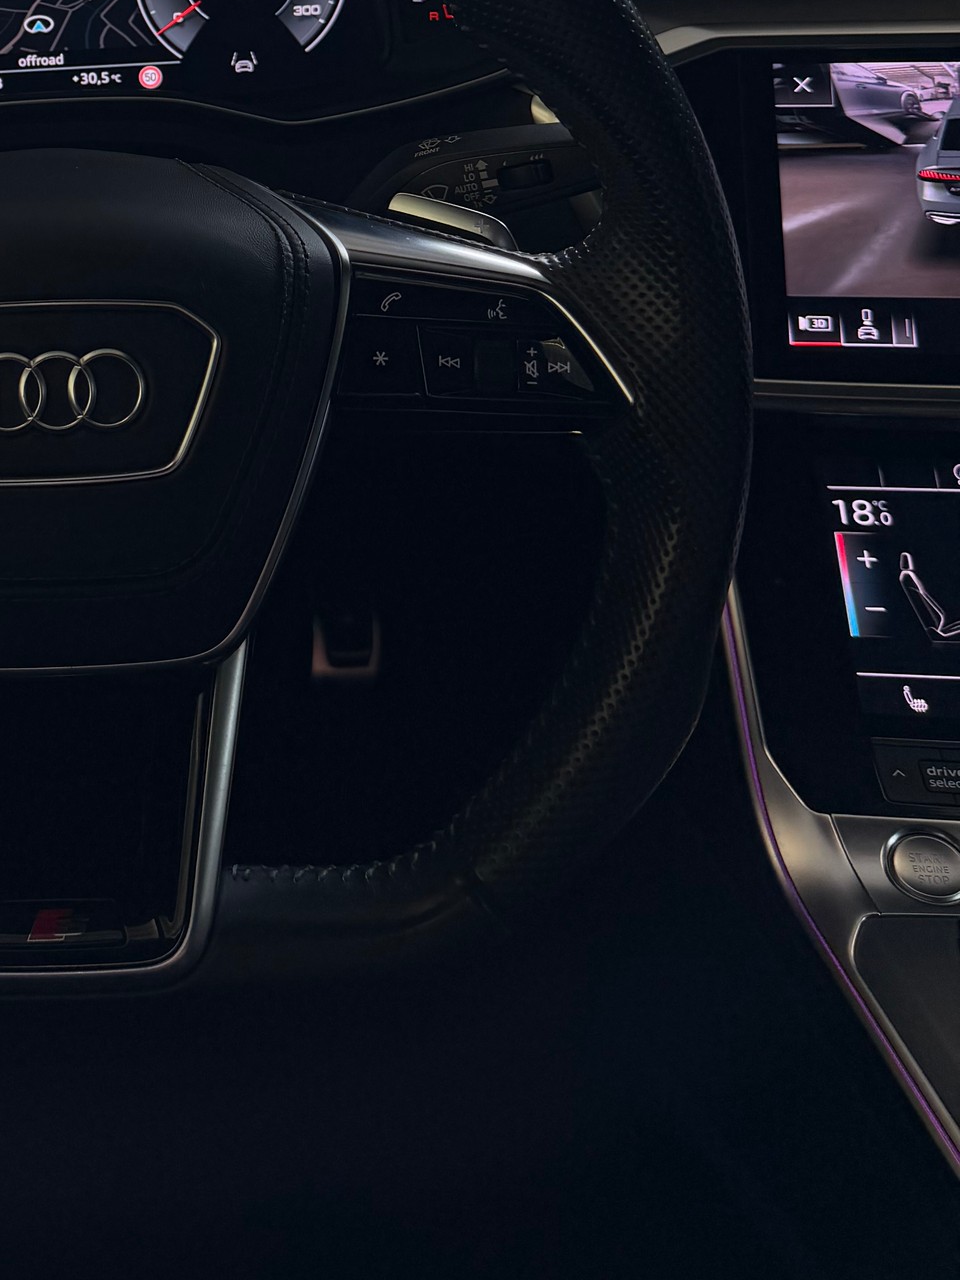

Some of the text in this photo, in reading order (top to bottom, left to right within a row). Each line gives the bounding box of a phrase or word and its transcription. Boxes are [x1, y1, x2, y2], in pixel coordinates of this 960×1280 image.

[293, 5, 321, 16] 300
[18, 53, 64, 67] offroad
[144, 71, 157, 82] 50
[414, 147, 440, 158] FRONT
[463, 164, 474, 172] HI
[463, 172, 476, 182] LO
[454, 183, 478, 194] AUTO
[463, 192, 480, 202] OFF
[811, 318, 827, 328] 3D
[912, 865, 950, 874] ENGINE
[918, 874, 950, 885] STOP
